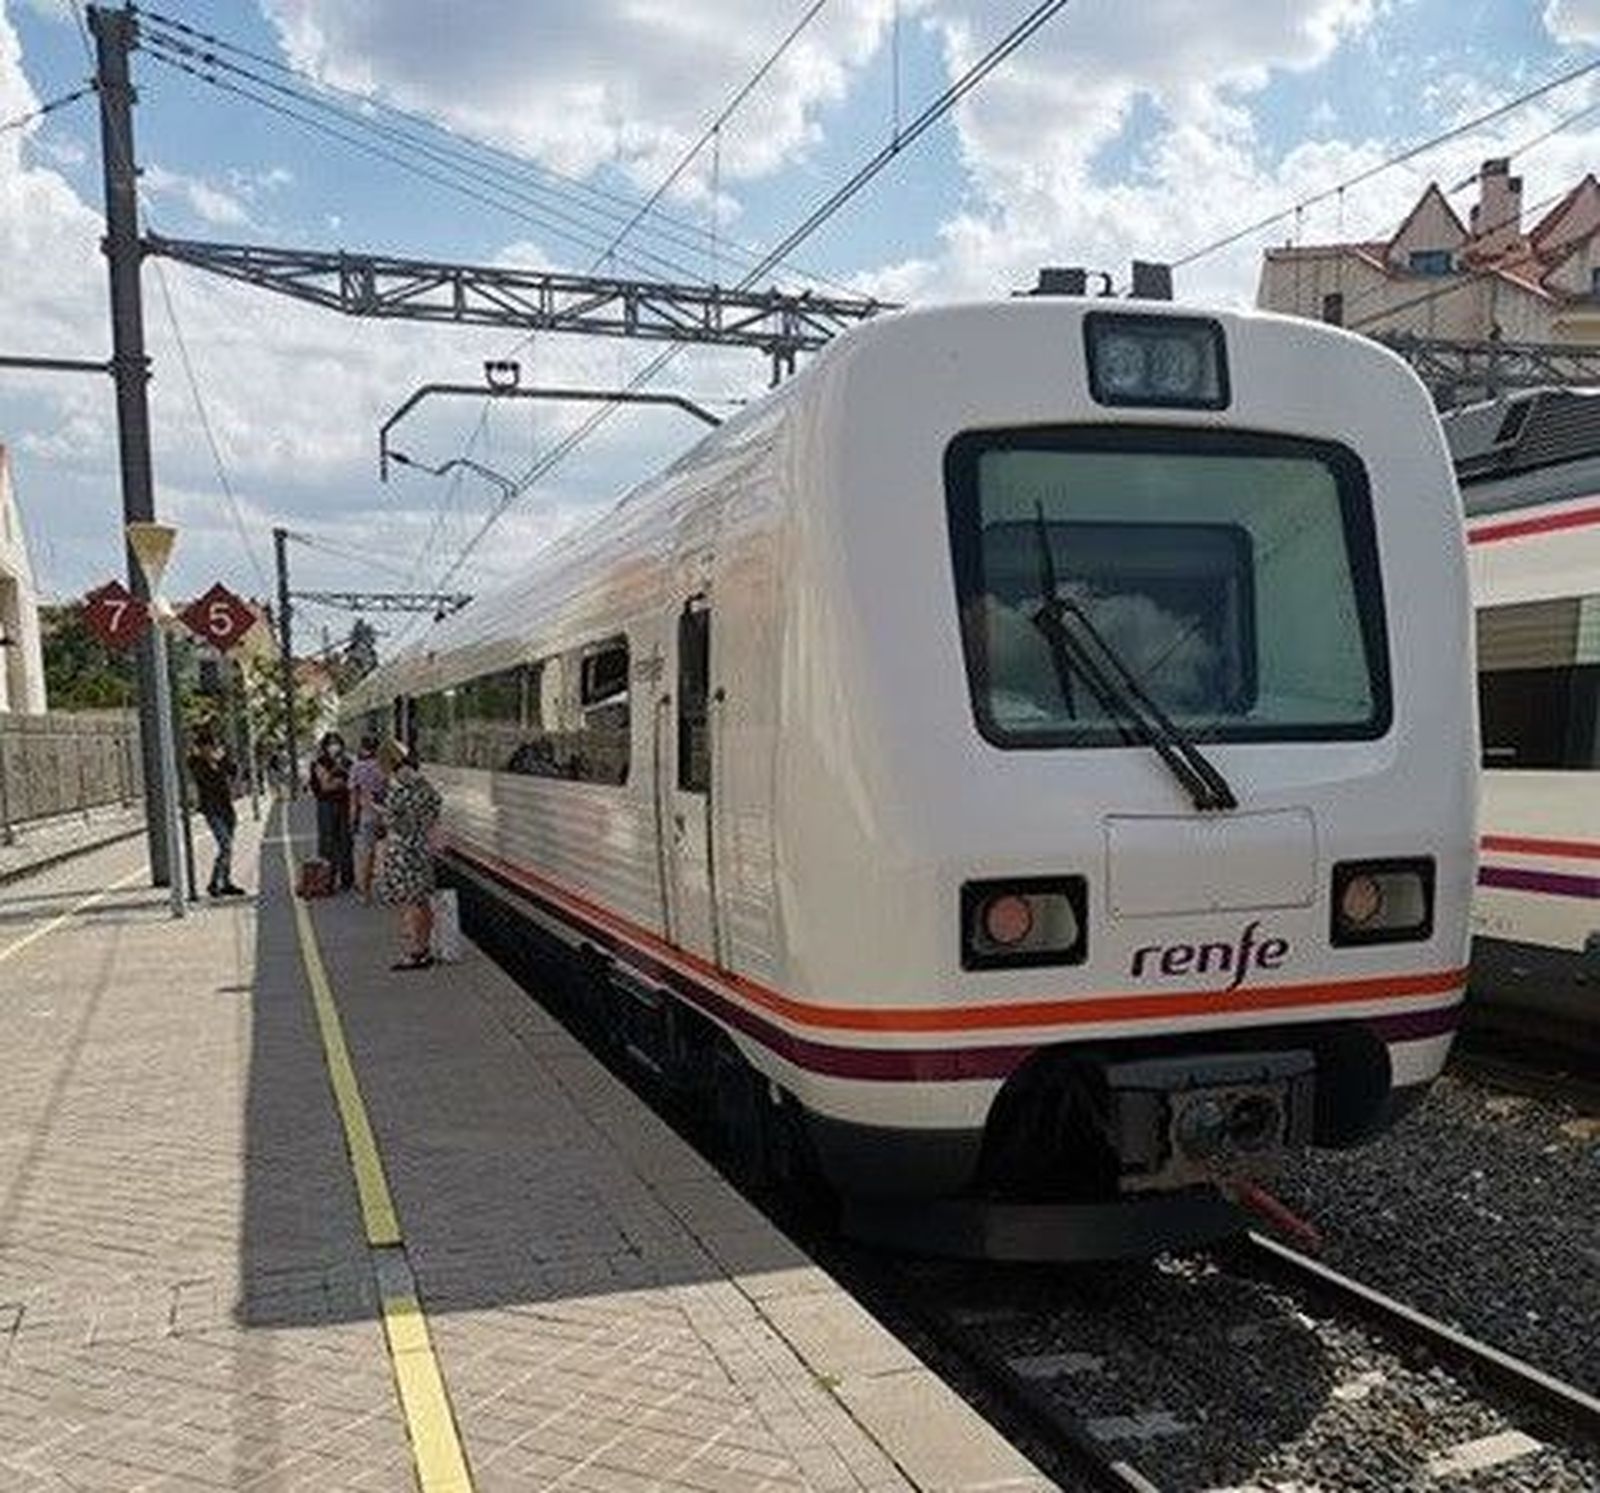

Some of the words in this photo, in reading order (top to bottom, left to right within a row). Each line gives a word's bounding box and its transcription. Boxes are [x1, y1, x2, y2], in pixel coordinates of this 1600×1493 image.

[103, 599, 128, 633] 7
[208, 602, 234, 636] 5
[1131, 921, 1290, 992] renfe
